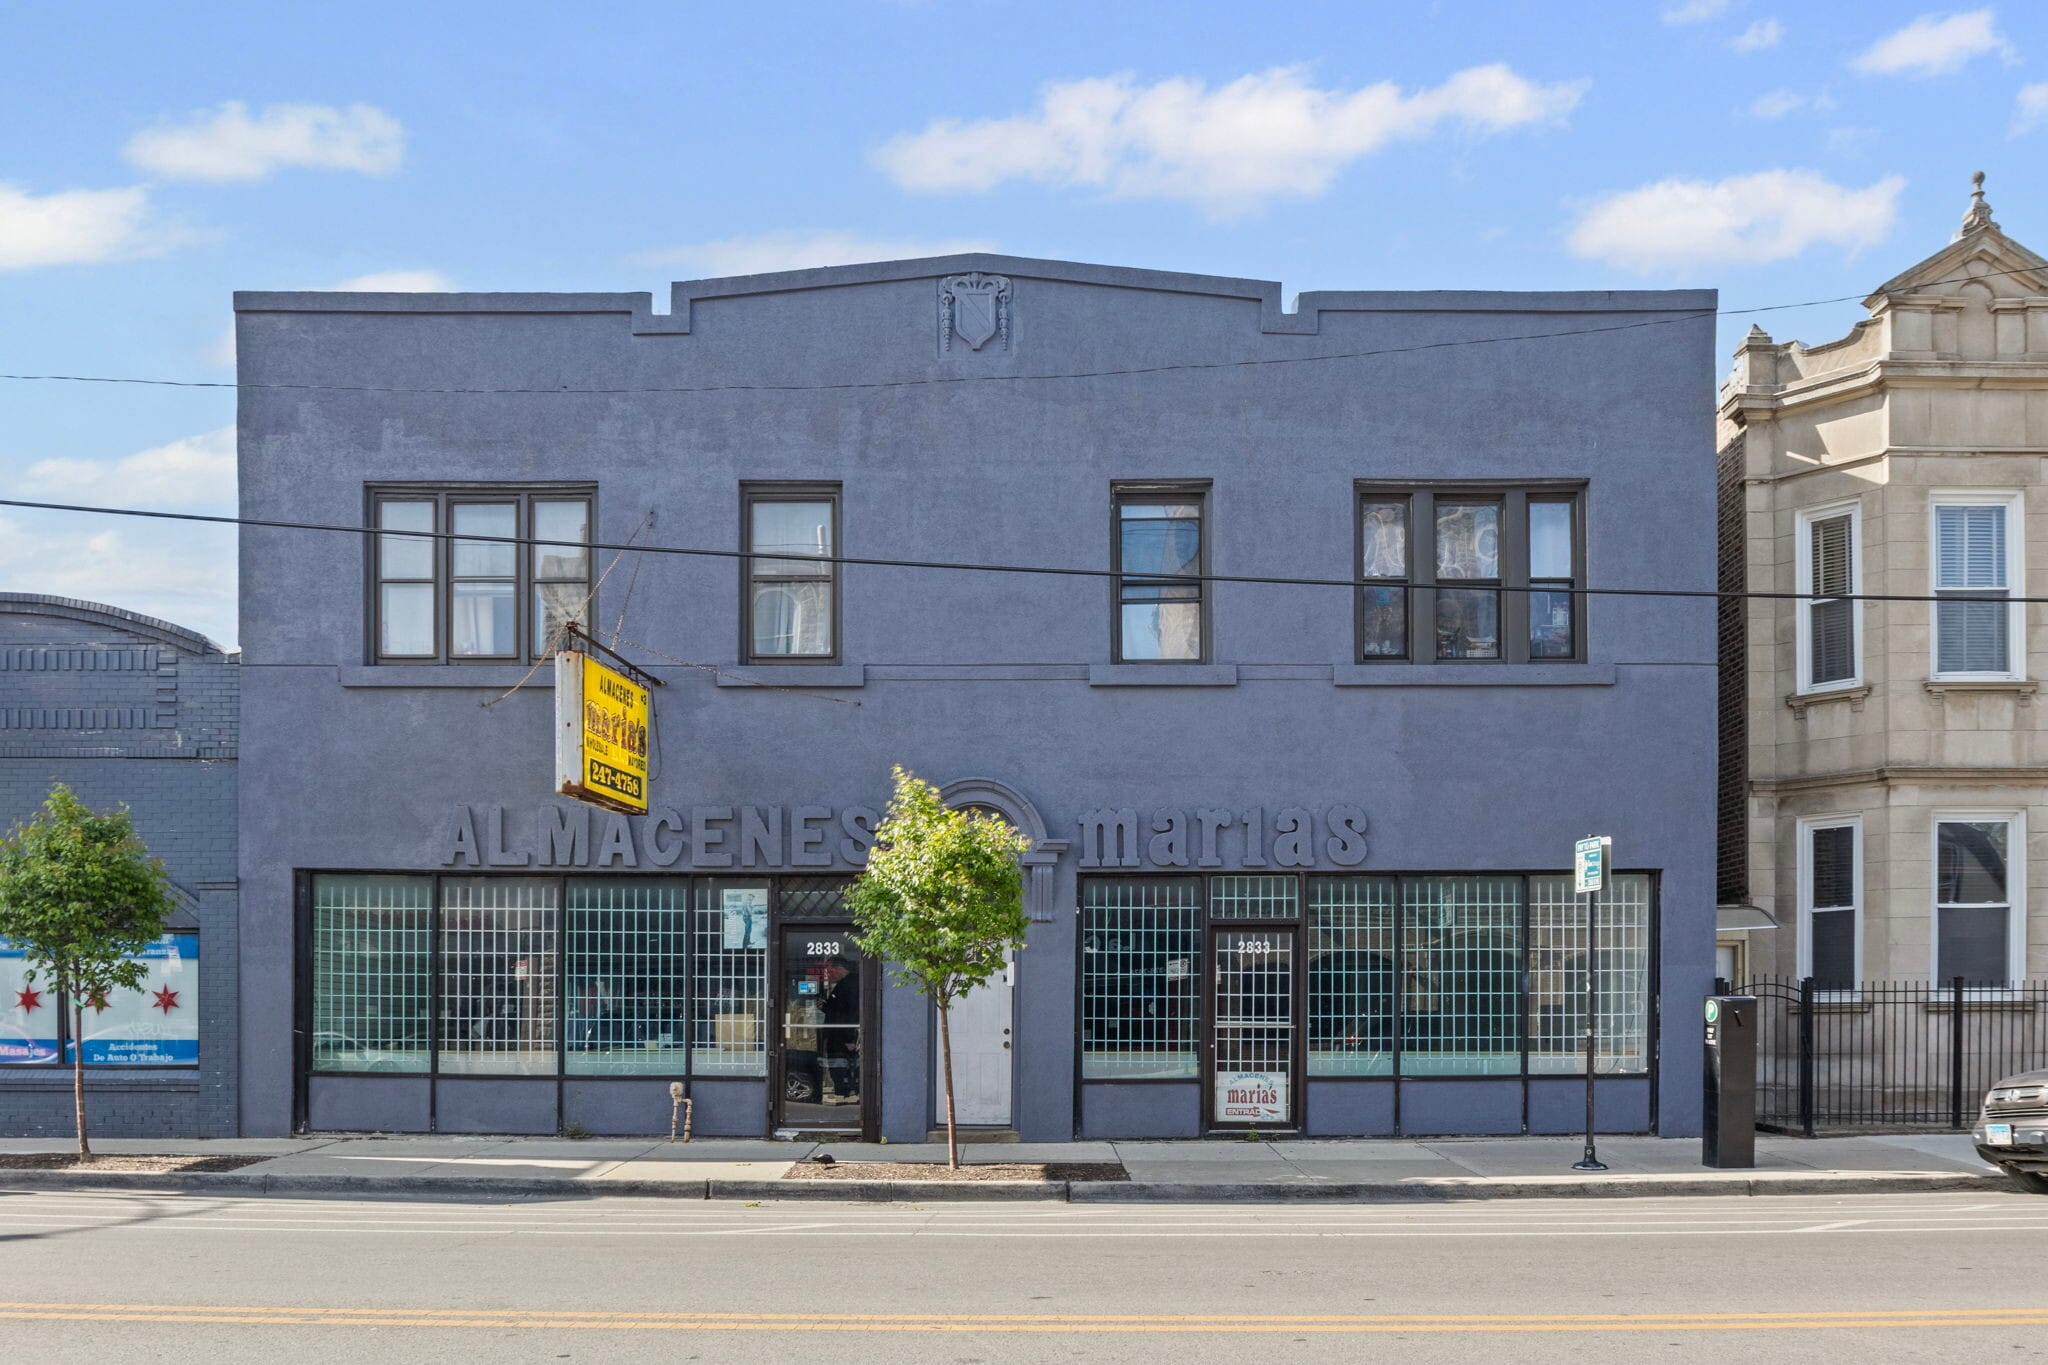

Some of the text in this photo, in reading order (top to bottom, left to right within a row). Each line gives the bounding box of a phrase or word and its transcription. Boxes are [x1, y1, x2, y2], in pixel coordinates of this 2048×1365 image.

[600, 674, 634, 709] ALMACENES
[592, 761, 640, 796] 247-4758
[440, 804, 881, 868] ALMACENES
[1077, 804, 1368, 868] marias
[807, 942, 840, 955] 2833
[1238, 941, 1270, 954] 2833
[0, 1044, 47, 1058] Masajes
[109, 1041, 158, 1051] Accidentes
[93, 1054, 105, 1062] De
[107, 1054, 128, 1062] Auto
[139, 1053, 174, 1063] Trabajo
[1229, 1072, 1274, 1086] ALMACENES
